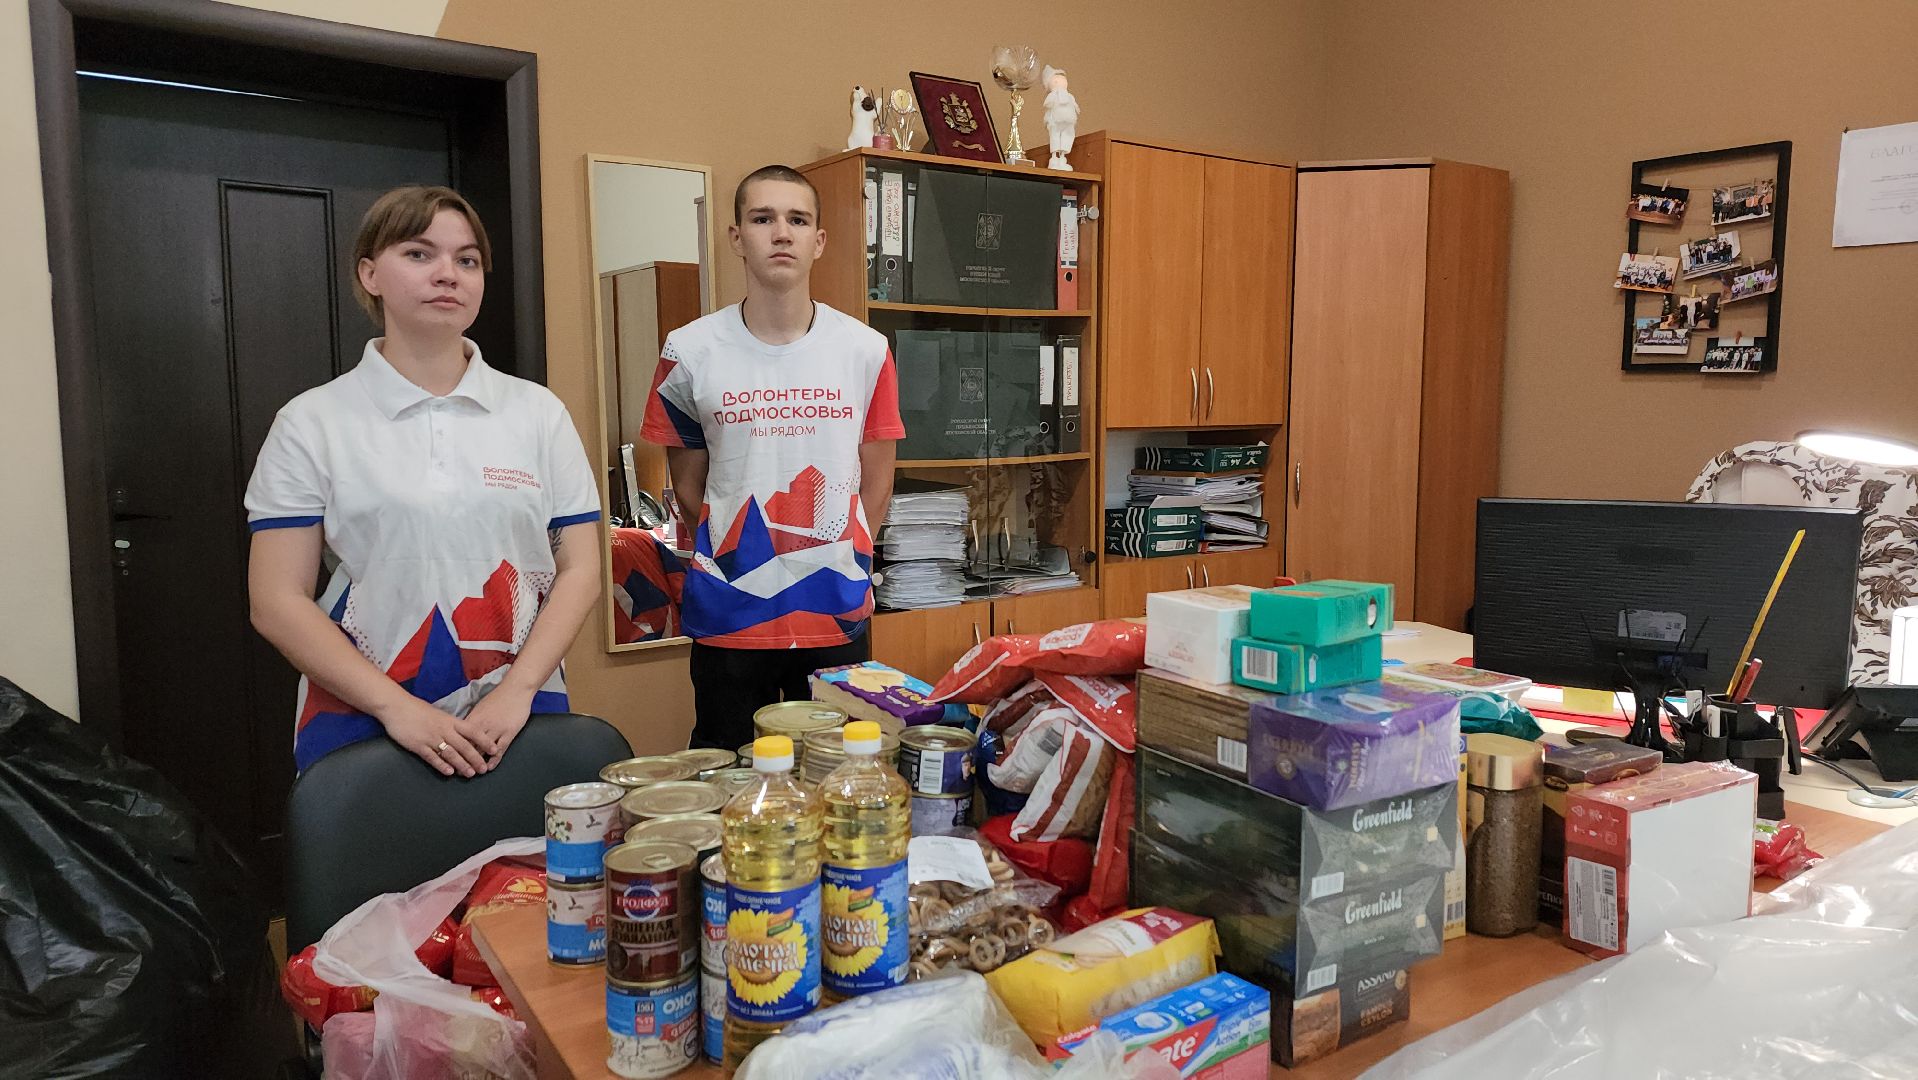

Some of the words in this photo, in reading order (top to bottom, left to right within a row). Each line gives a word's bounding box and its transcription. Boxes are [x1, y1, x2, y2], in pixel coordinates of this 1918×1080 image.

[722, 388, 841, 407] ВОЛОНТЕРЫ
[713, 405, 853, 426] ПОДМОСКОВЬЯ
[771, 425, 816, 437] РЯДОМ
[483, 466, 534, 480] ВОЛОНТЕРЫ
[1352, 799, 1413, 832] Greenfield
[1344, 888, 1403, 924] Greenfield
